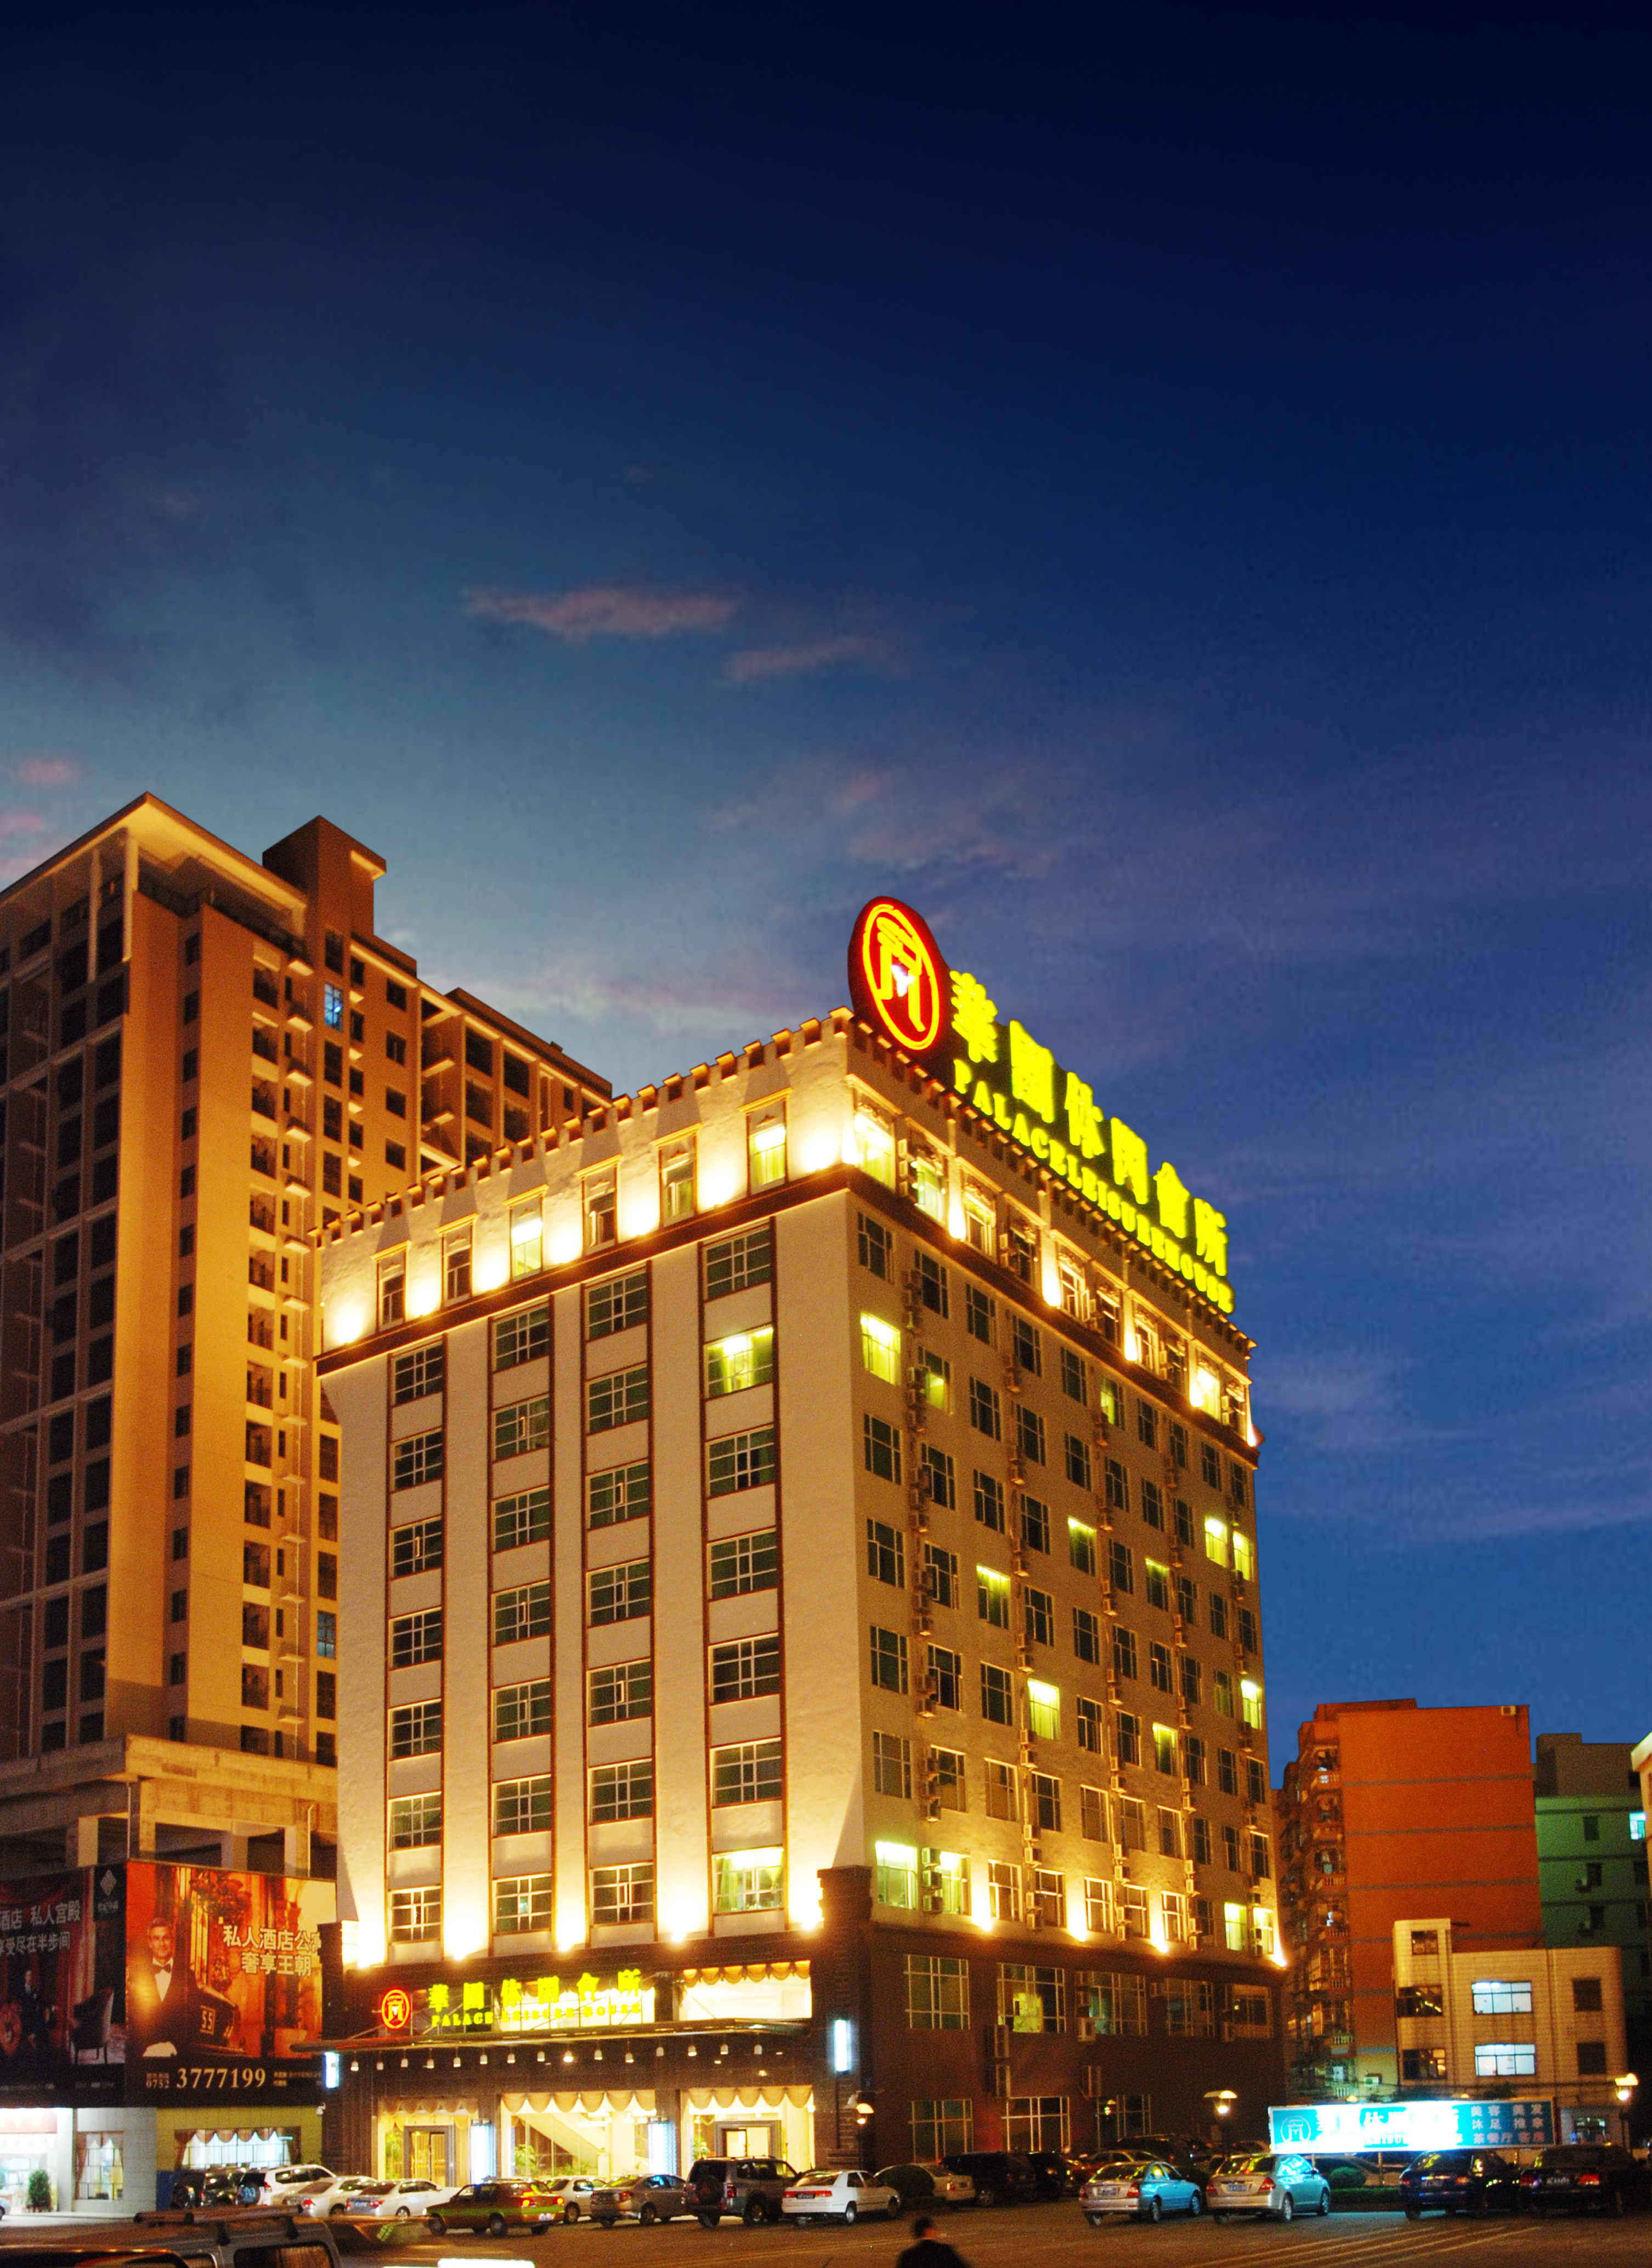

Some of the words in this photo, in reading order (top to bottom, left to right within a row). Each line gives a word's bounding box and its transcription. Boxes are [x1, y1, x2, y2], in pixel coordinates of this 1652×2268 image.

[953, 1059, 1067, 1176] PALACE
[1067, 1154, 1166, 1259] LEISURE
[1165, 1239, 1235, 1313] HOUSE
[241, 1951, 312, 1977] 奢享王朝
[431, 2011, 494, 2027] PALACE
[501, 2008, 575, 2023] LEISURE
[583, 2002, 641, 2018] HOUSE
[176, 2068, 266, 2089] 3777199
